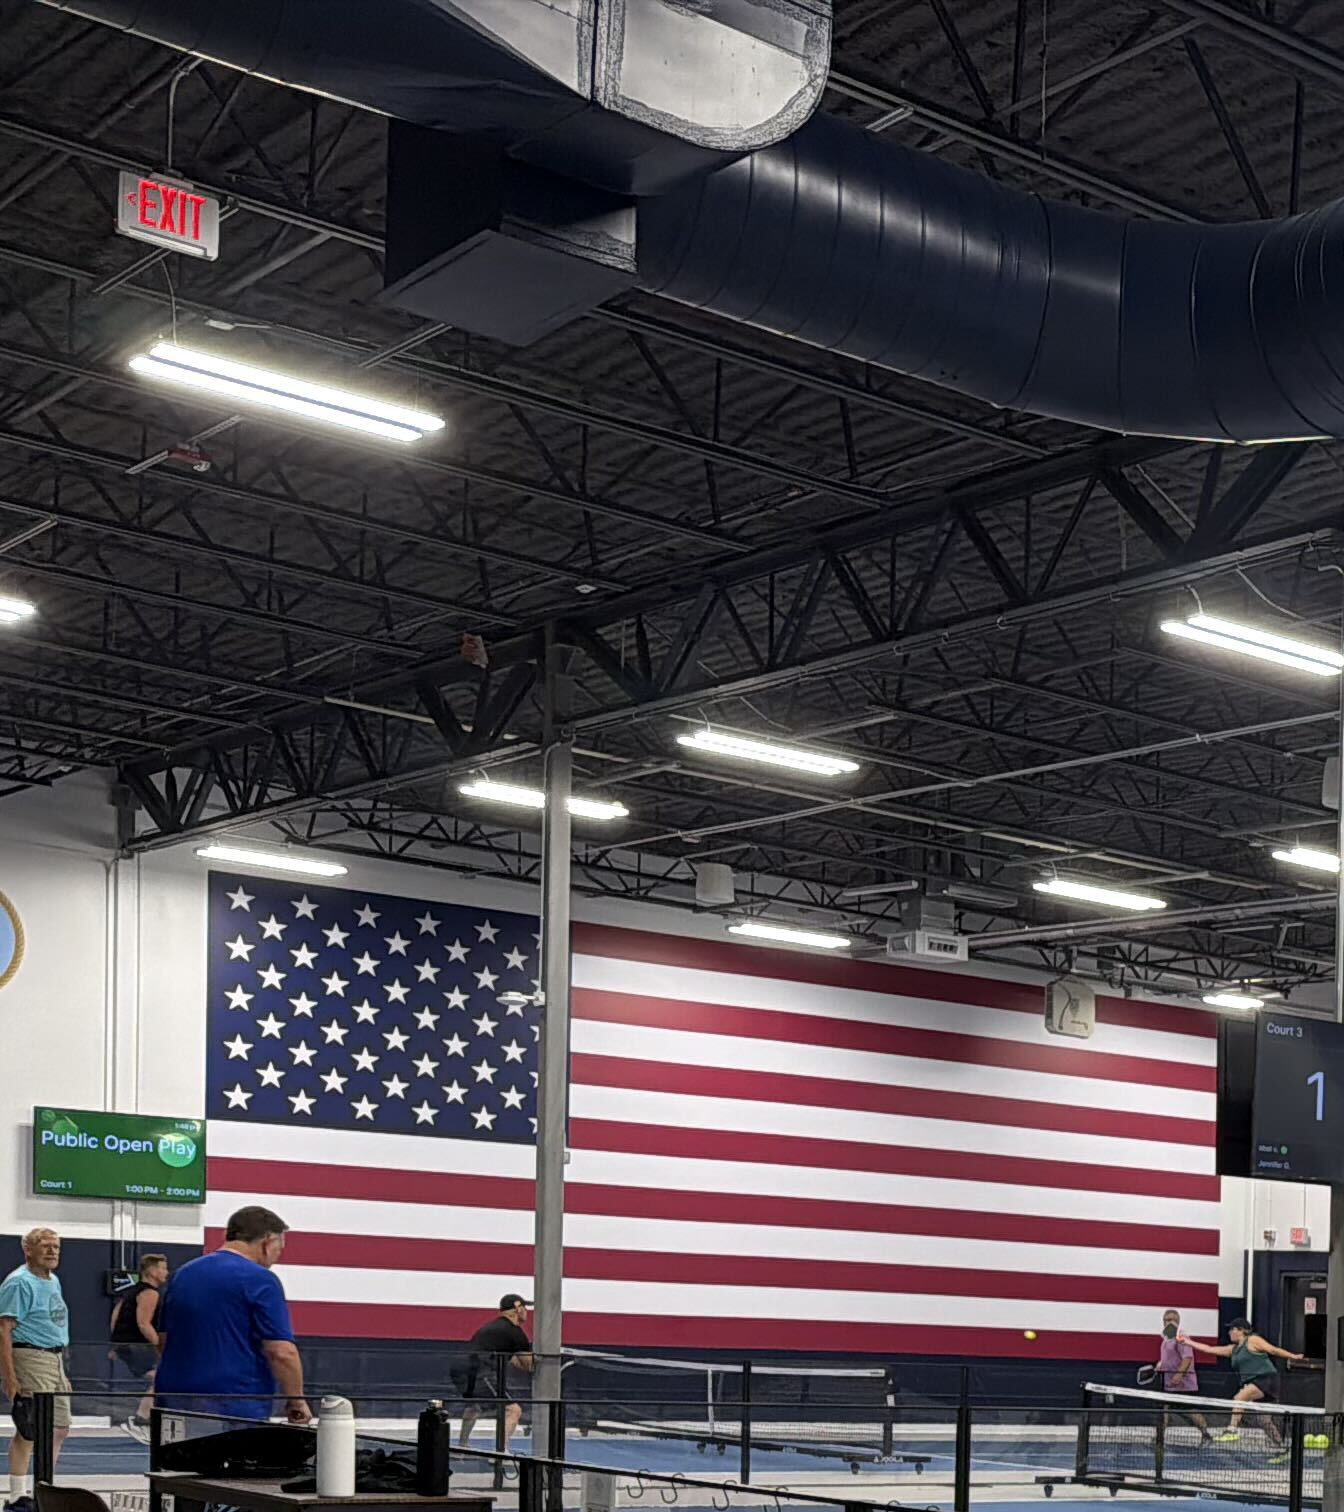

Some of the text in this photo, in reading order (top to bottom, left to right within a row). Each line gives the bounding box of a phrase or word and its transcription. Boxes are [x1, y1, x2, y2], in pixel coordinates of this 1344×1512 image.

[138, 178, 207, 240] EXIT
[1266, 1022, 1303, 1037] Court 3
[1307, 1072, 1324, 1121] 1
[41, 1130, 197, 1159] Public Open Play
[40, 1179, 67, 1190] Court
[126, 1185, 144, 1195] 1:00
[144, 1186, 158, 1196] PM
[185, 1188, 200, 1198] PM
